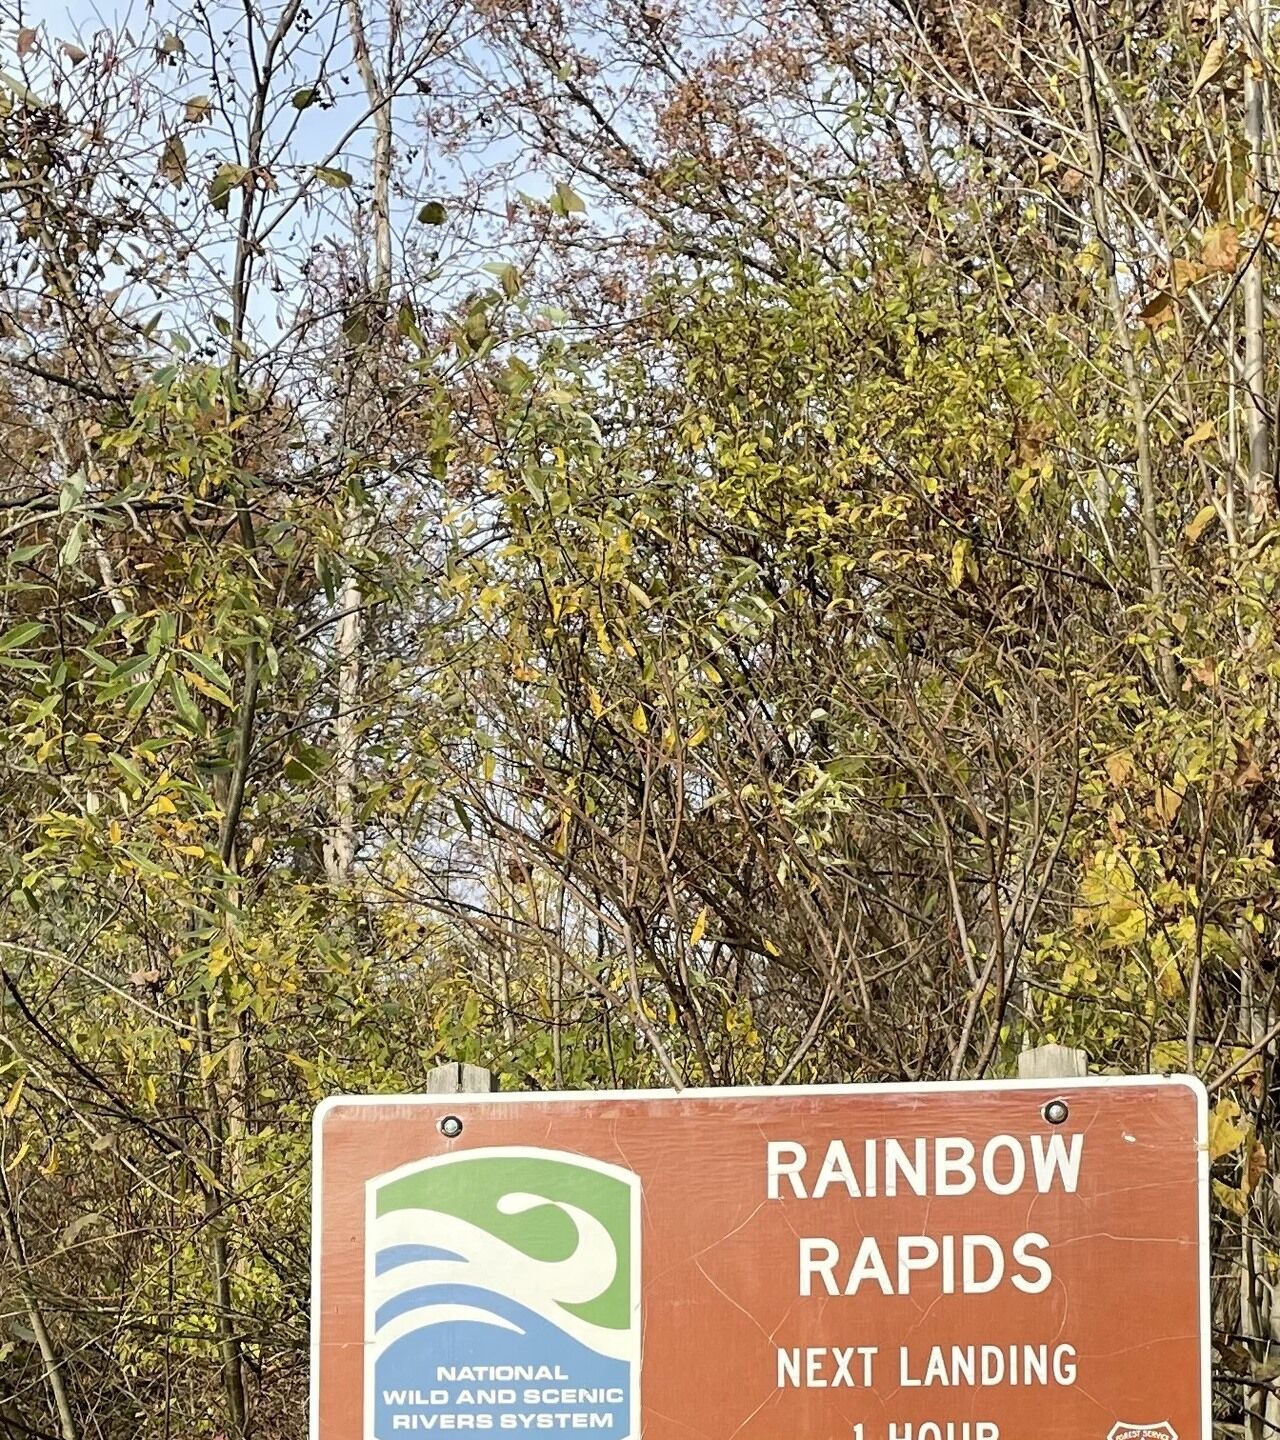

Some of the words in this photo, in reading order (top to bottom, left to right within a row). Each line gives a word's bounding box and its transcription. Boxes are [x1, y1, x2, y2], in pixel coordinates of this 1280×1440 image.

[767, 1133, 1084, 1199] RAINBOW
[799, 1232, 1053, 1297] RAPIDS
[436, 1365, 569, 1382] NATIONAL
[777, 1347, 878, 1388] NEXT
[899, 1343, 1077, 1387] LANDING
[382, 1390, 449, 1406] WILD
[455, 1389, 517, 1405] AND
[523, 1388, 624, 1404] SCENIC
[392, 1413, 494, 1430] RIVERS
[499, 1412, 614, 1429] SYSTEM
